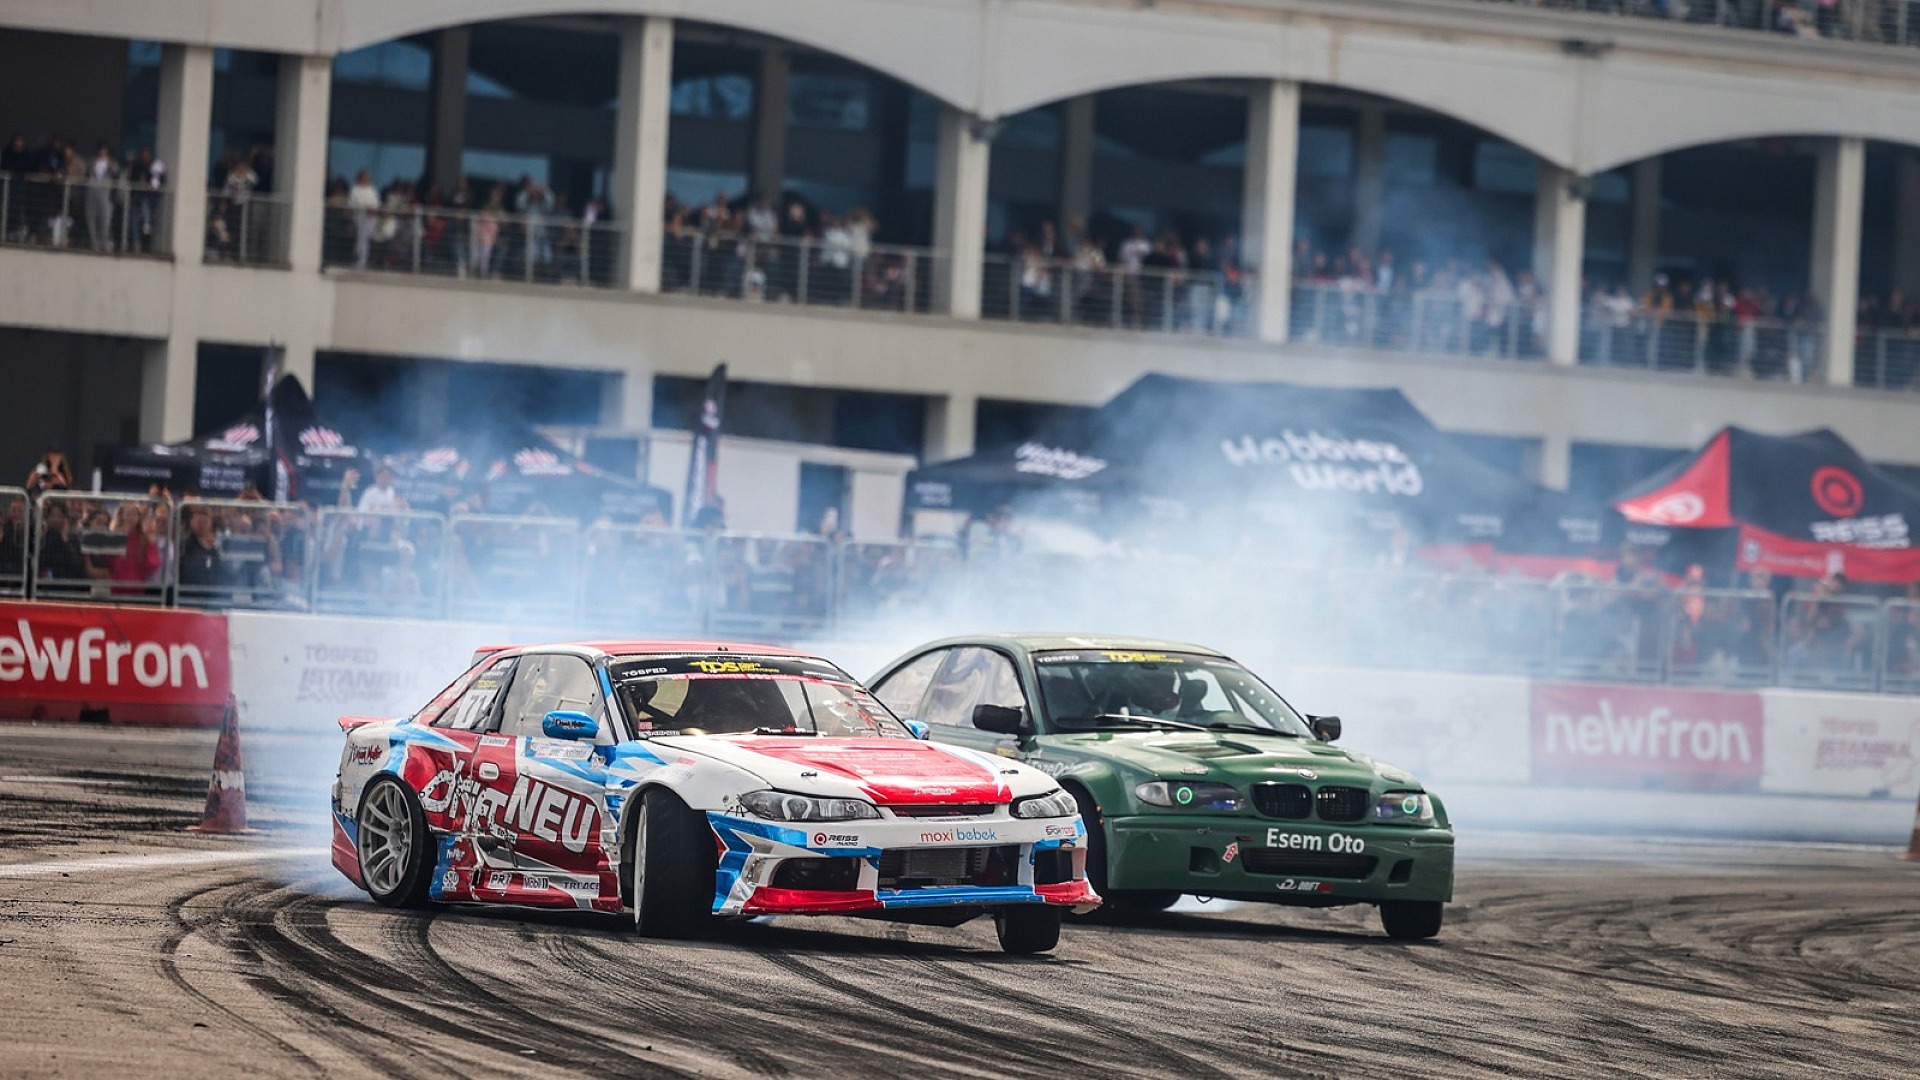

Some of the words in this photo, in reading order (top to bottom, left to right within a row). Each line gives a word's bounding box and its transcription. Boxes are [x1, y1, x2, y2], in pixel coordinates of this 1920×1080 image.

[621, 667, 668, 677] TOSFED
[1545, 697, 1751, 763] newfron
[828, 834, 859, 842] REISS
[920, 829, 954, 843] moxi
[956, 828, 997, 841] bebek
[1266, 828, 1322, 851] Esem
[1328, 832, 1365, 853] Oto
